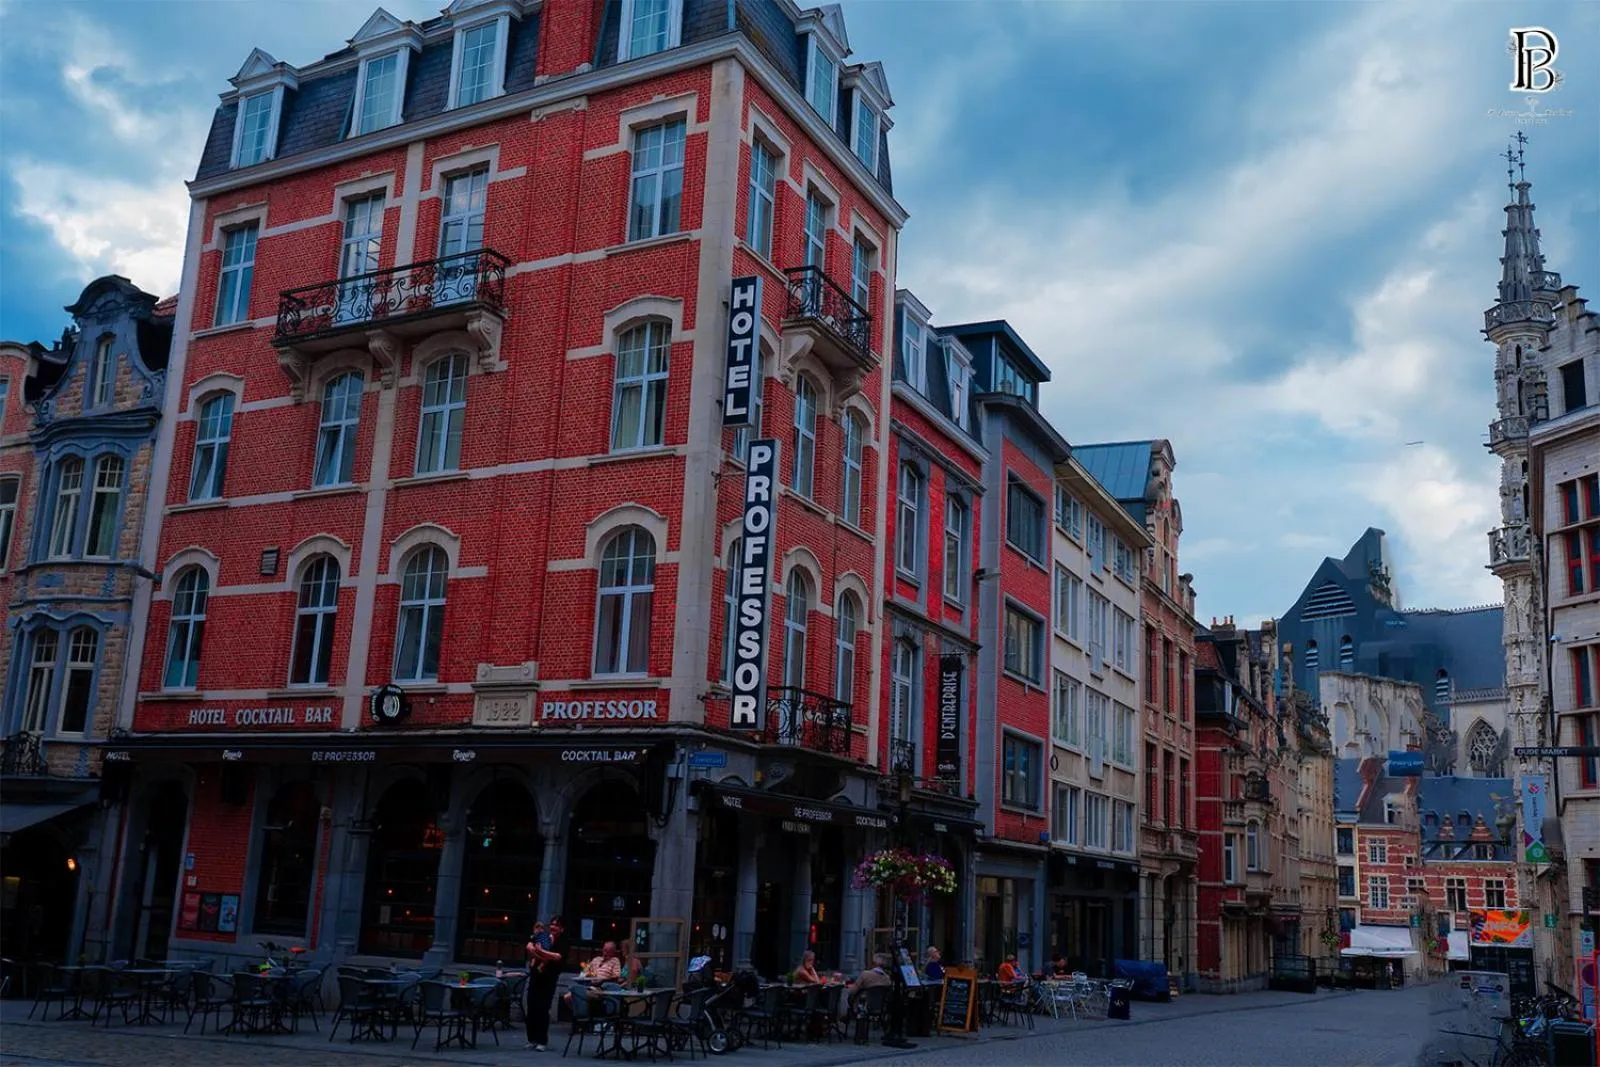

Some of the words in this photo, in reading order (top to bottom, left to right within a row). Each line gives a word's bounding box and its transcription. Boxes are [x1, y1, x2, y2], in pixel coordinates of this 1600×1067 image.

[726, 284, 754, 417] HOTEL
[733, 445, 772, 724] PROFESSOR
[541, 699, 658, 720] PROFESSOR
[941, 671, 958, 739] D'ENTREPRISE
[189, 709, 226, 725] HOTEL
[235, 707, 295, 726] COCKTAIL
[304, 707, 332, 723] BAR
[106, 751, 131, 761] HOTEL
[311, 751, 324, 761] DE
[324, 751, 377, 761] PROFESSOR
[560, 750, 612, 761] COCKTAIL
[613, 750, 637, 761] BAR
[1516, 748, 1539, 756] OUDE
[1540, 748, 1569, 756] MARKT
[722, 795, 743, 809] HOTEL
